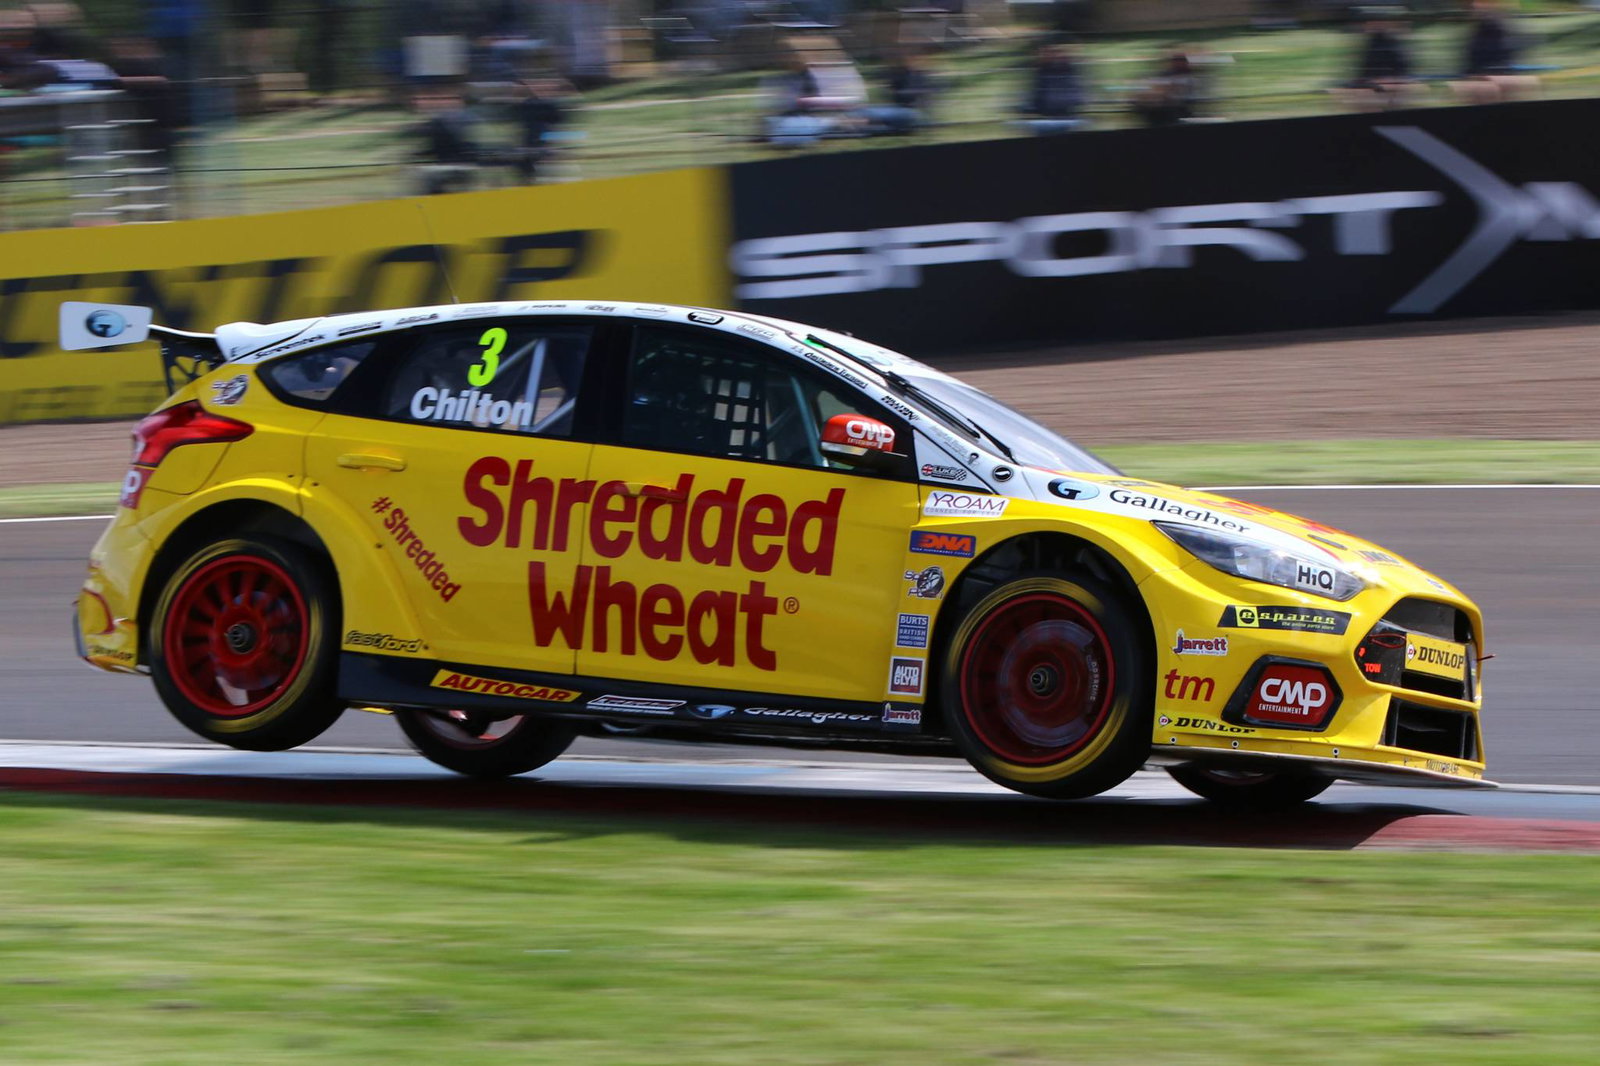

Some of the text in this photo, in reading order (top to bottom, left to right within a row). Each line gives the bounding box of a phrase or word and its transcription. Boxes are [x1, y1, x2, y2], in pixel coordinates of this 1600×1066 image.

[730, 190, 1442, 300] SPORT
[467, 327, 508, 387] 3
[410, 386, 535, 427] Chilton
[932, 493, 1005, 512] YROAM
[1109, 489, 1250, 534] Gallagher
[457, 456, 846, 577] Shredded
[371, 496, 462, 603] #Shredded
[919, 533, 972, 551] DNA
[1297, 563, 1335, 590] HiQ
[900, 615, 927, 625] BURTS
[1364, 662, 1382, 674] TOW
[1418, 646, 1465, 670] DUNLOP
[893, 674, 919, 687] GLYM
[895, 666, 920, 678] AUTO
[439, 674, 572, 701] AUTOCAR
[1164, 668, 1216, 702] tm
[1260, 678, 1327, 715] CMP
[743, 706, 879, 724] Gallagher
[1258, 703, 1303, 715] ENTERTAINMENT
[1174, 716, 1256, 734] DUNLOP
